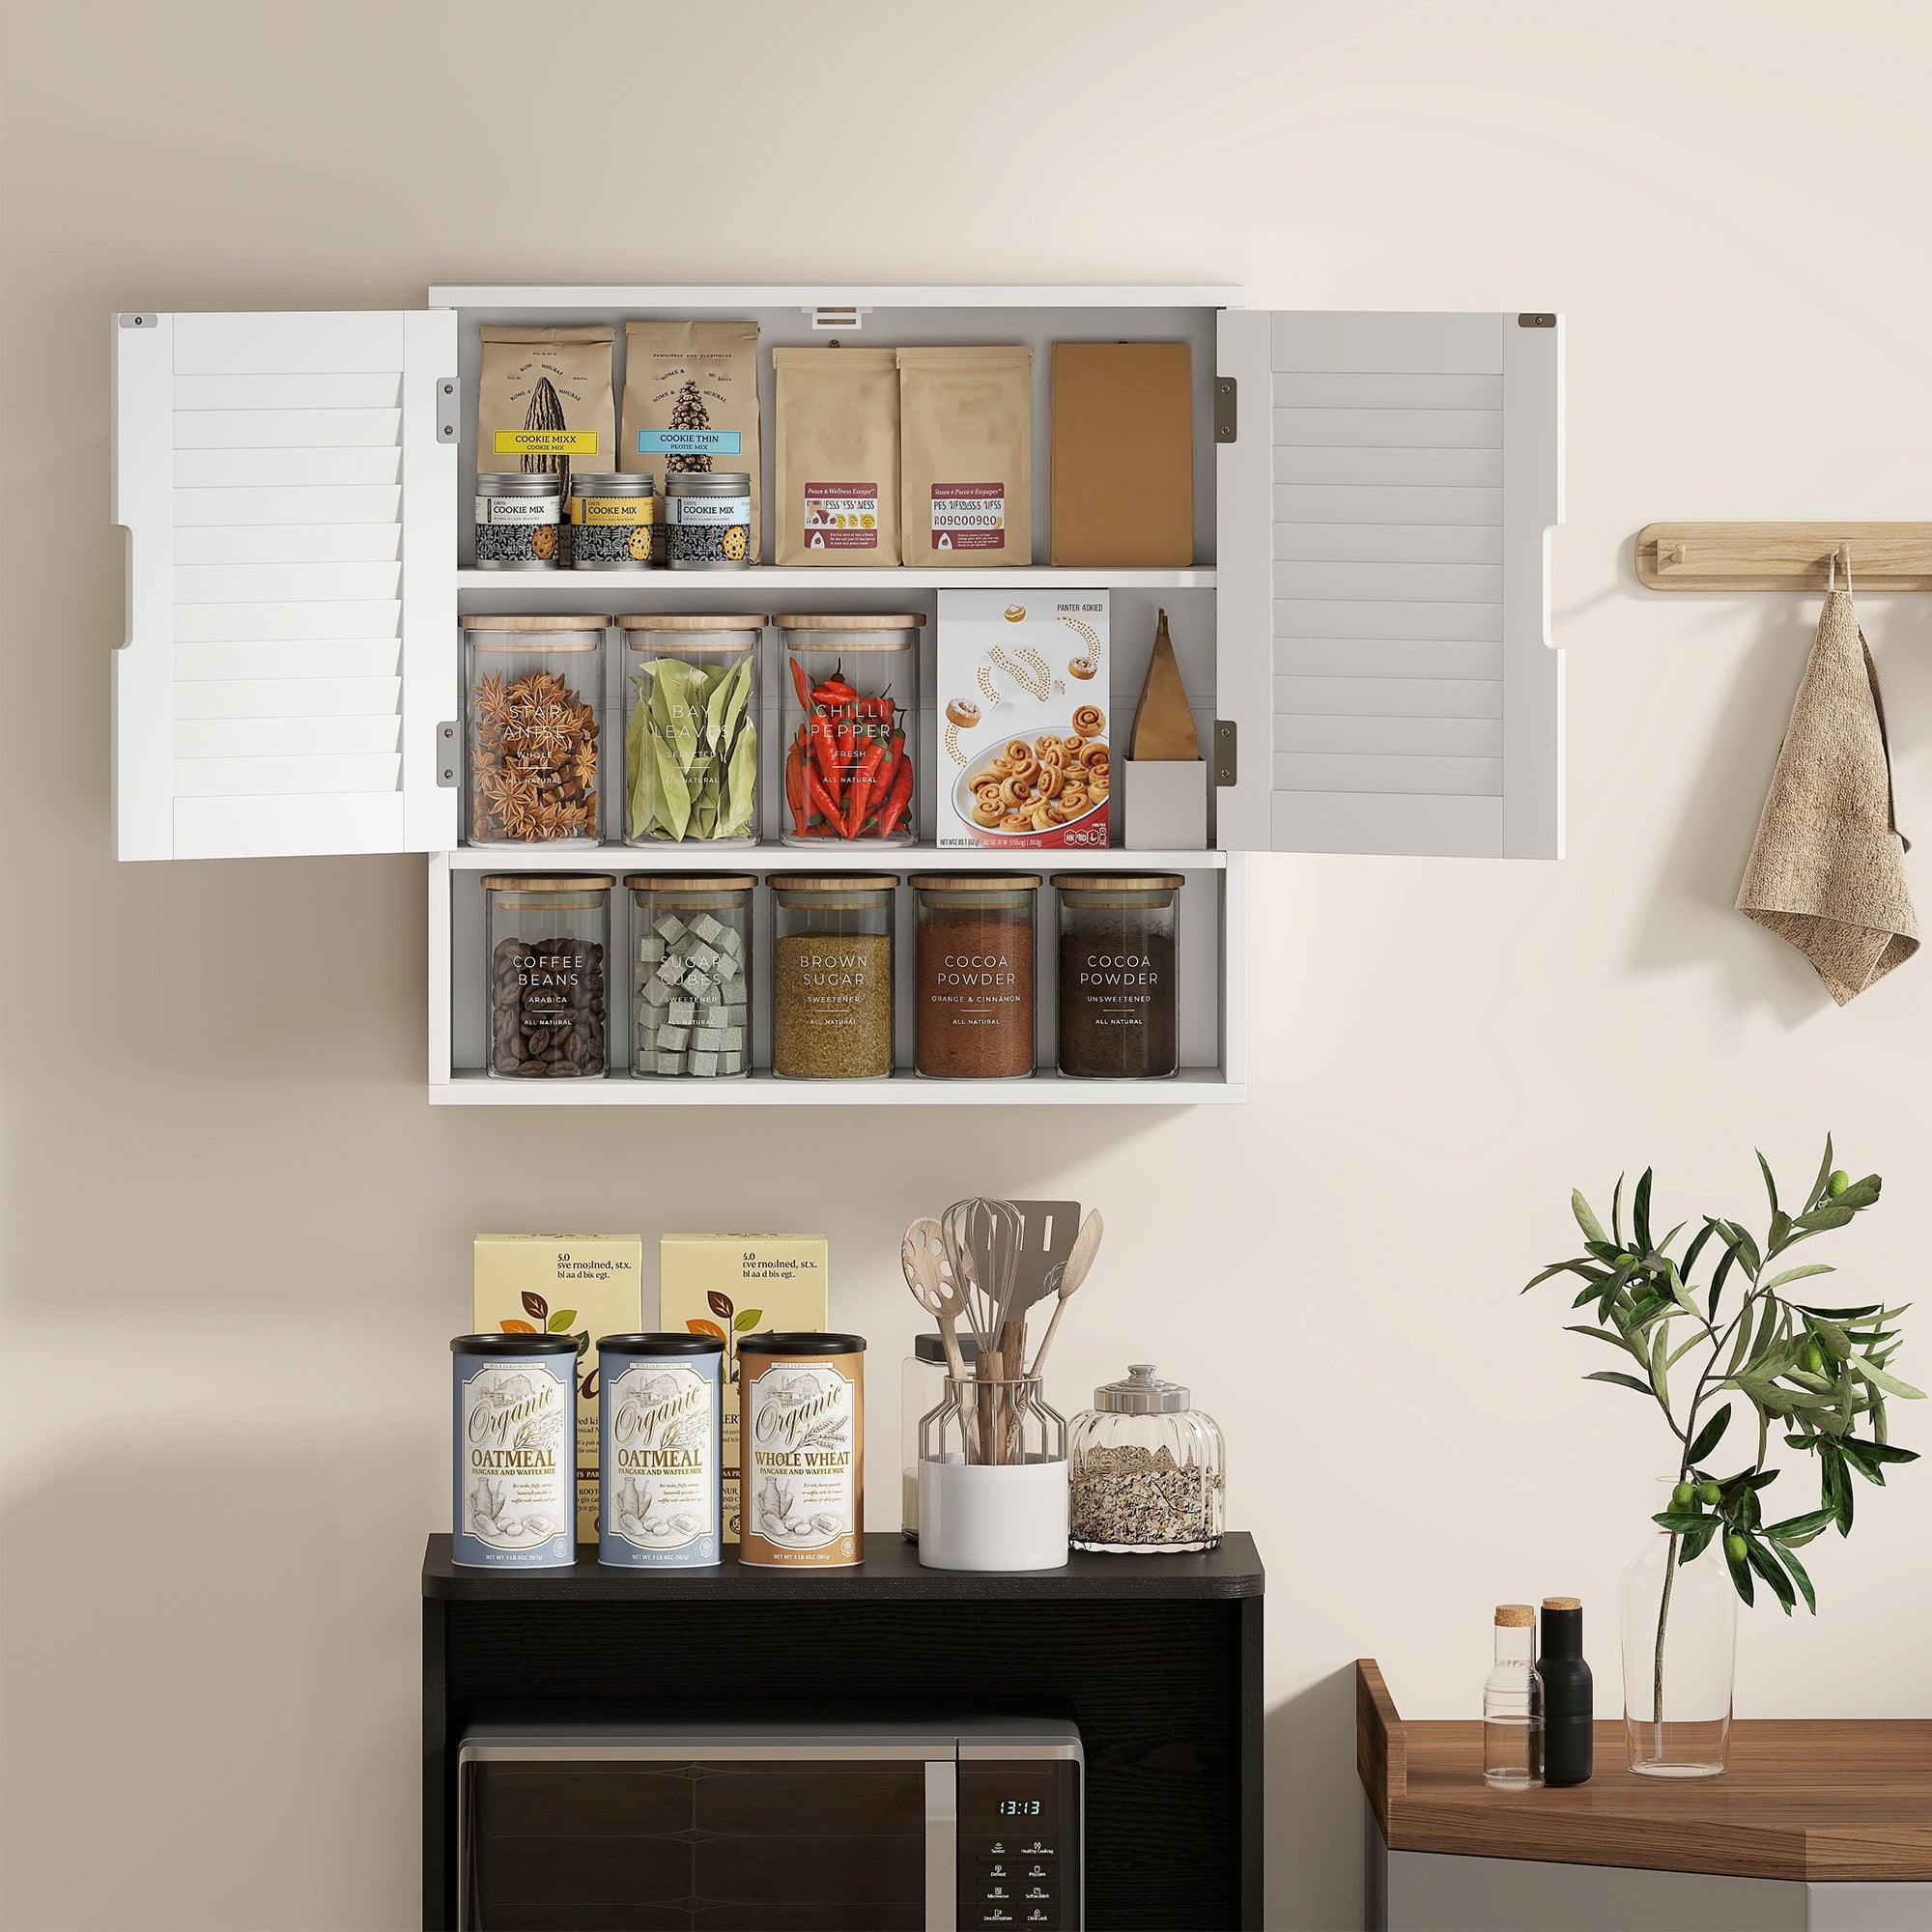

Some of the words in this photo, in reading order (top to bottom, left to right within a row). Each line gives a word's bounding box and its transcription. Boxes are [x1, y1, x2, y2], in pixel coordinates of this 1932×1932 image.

[515, 435, 550, 443] COOKIE
[509, 705, 559, 719] STAR
[673, 705, 711, 718] BAY
[816, 704, 883, 718] CHILLI
[503, 725, 565, 738] ANISE
[654, 725, 729, 738] LEAVES
[810, 724, 890, 737] PEPPER
[513, 955, 582, 968] COFFEE
[661, 956, 722, 968] SUGAR
[800, 955, 867, 968] BROWN
[945, 955, 1008, 967] COCOA
[1088, 955, 1151, 967] COCOA
[518, 974, 579, 985] BEANS
[661, 974, 722, 986] CUBES
[803, 974, 864, 985] SUGAR
[938, 973, 1015, 985] POWDER
[1080, 973, 1158, 985] POWDER
[557, 1253, 570, 1262] 5.0
[469, 1384, 553, 1448] Organic
[615, 1384, 699, 1448] Organic
[755, 1384, 841, 1447] Organic
[471, 1449, 556, 1467] OATMEAL
[618, 1449, 703, 1467] OATMEAL
[754, 1451, 802, 1466] WHOLE
[804, 1451, 850, 1466] WHEAT
[1000, 1801, 1040, 1815] 13:13
